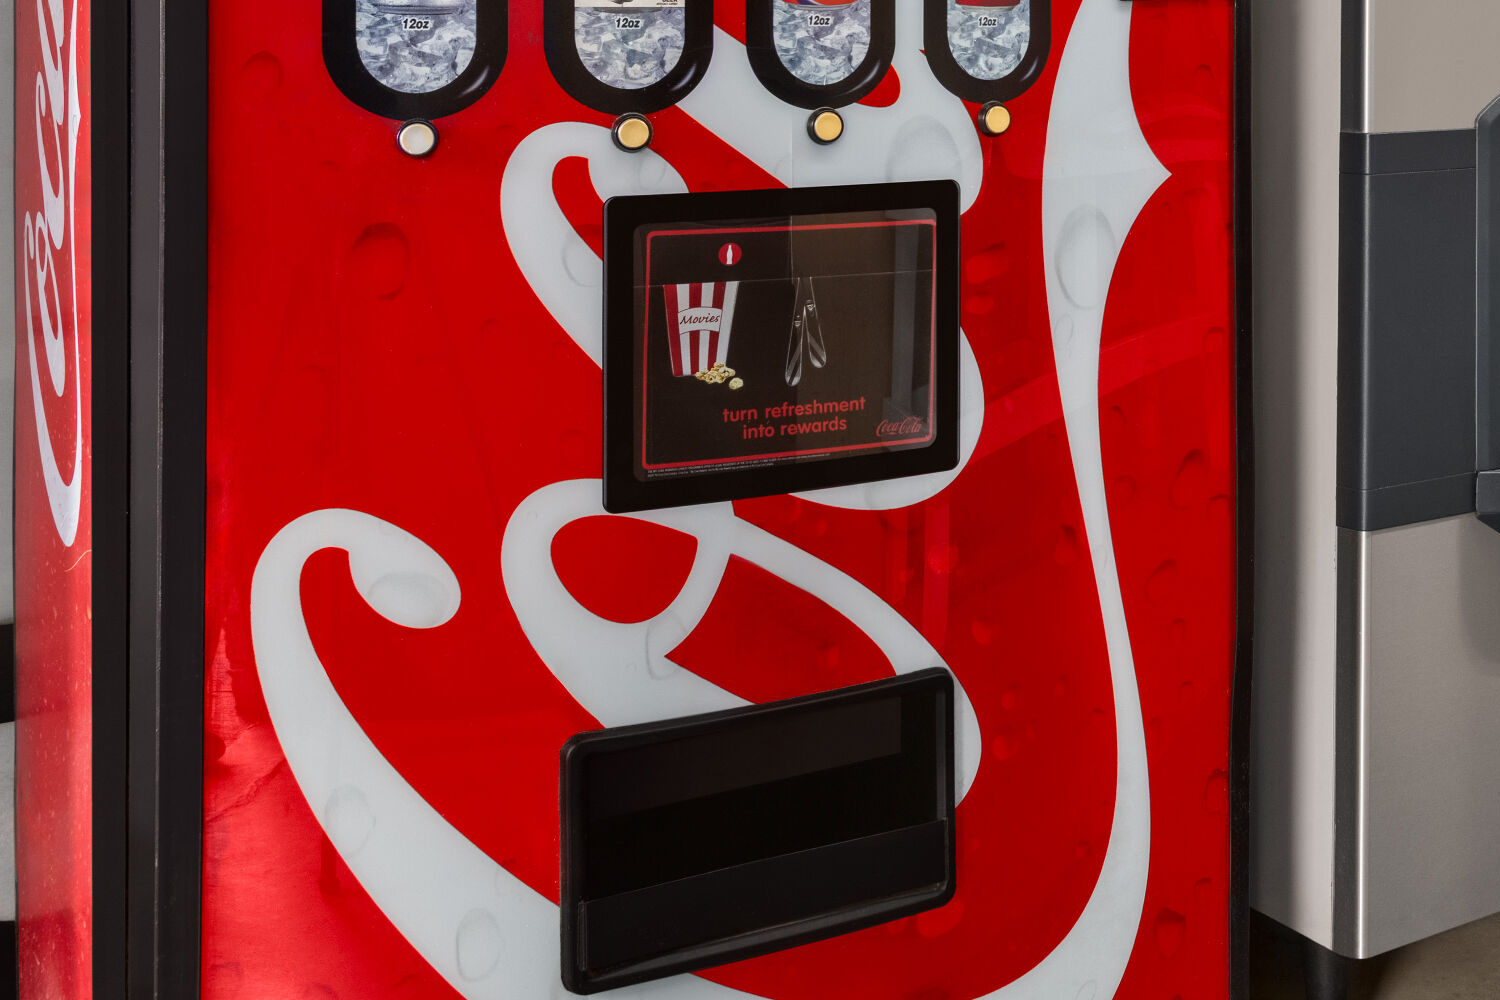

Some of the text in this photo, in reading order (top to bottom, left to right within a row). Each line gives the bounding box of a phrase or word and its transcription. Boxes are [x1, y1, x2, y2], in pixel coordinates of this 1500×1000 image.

[403, 18, 430, 29] 12oz
[615, 18, 641, 28] 12oz
[808, 15, 831, 25] 12oz
[979, 17, 997, 27] 12oz
[680, 312, 720, 325] Movies
[722, 396, 866, 423] turn refreshment
[743, 416, 848, 439] into rewards
[876, 415, 923, 437] Coca-Cola
